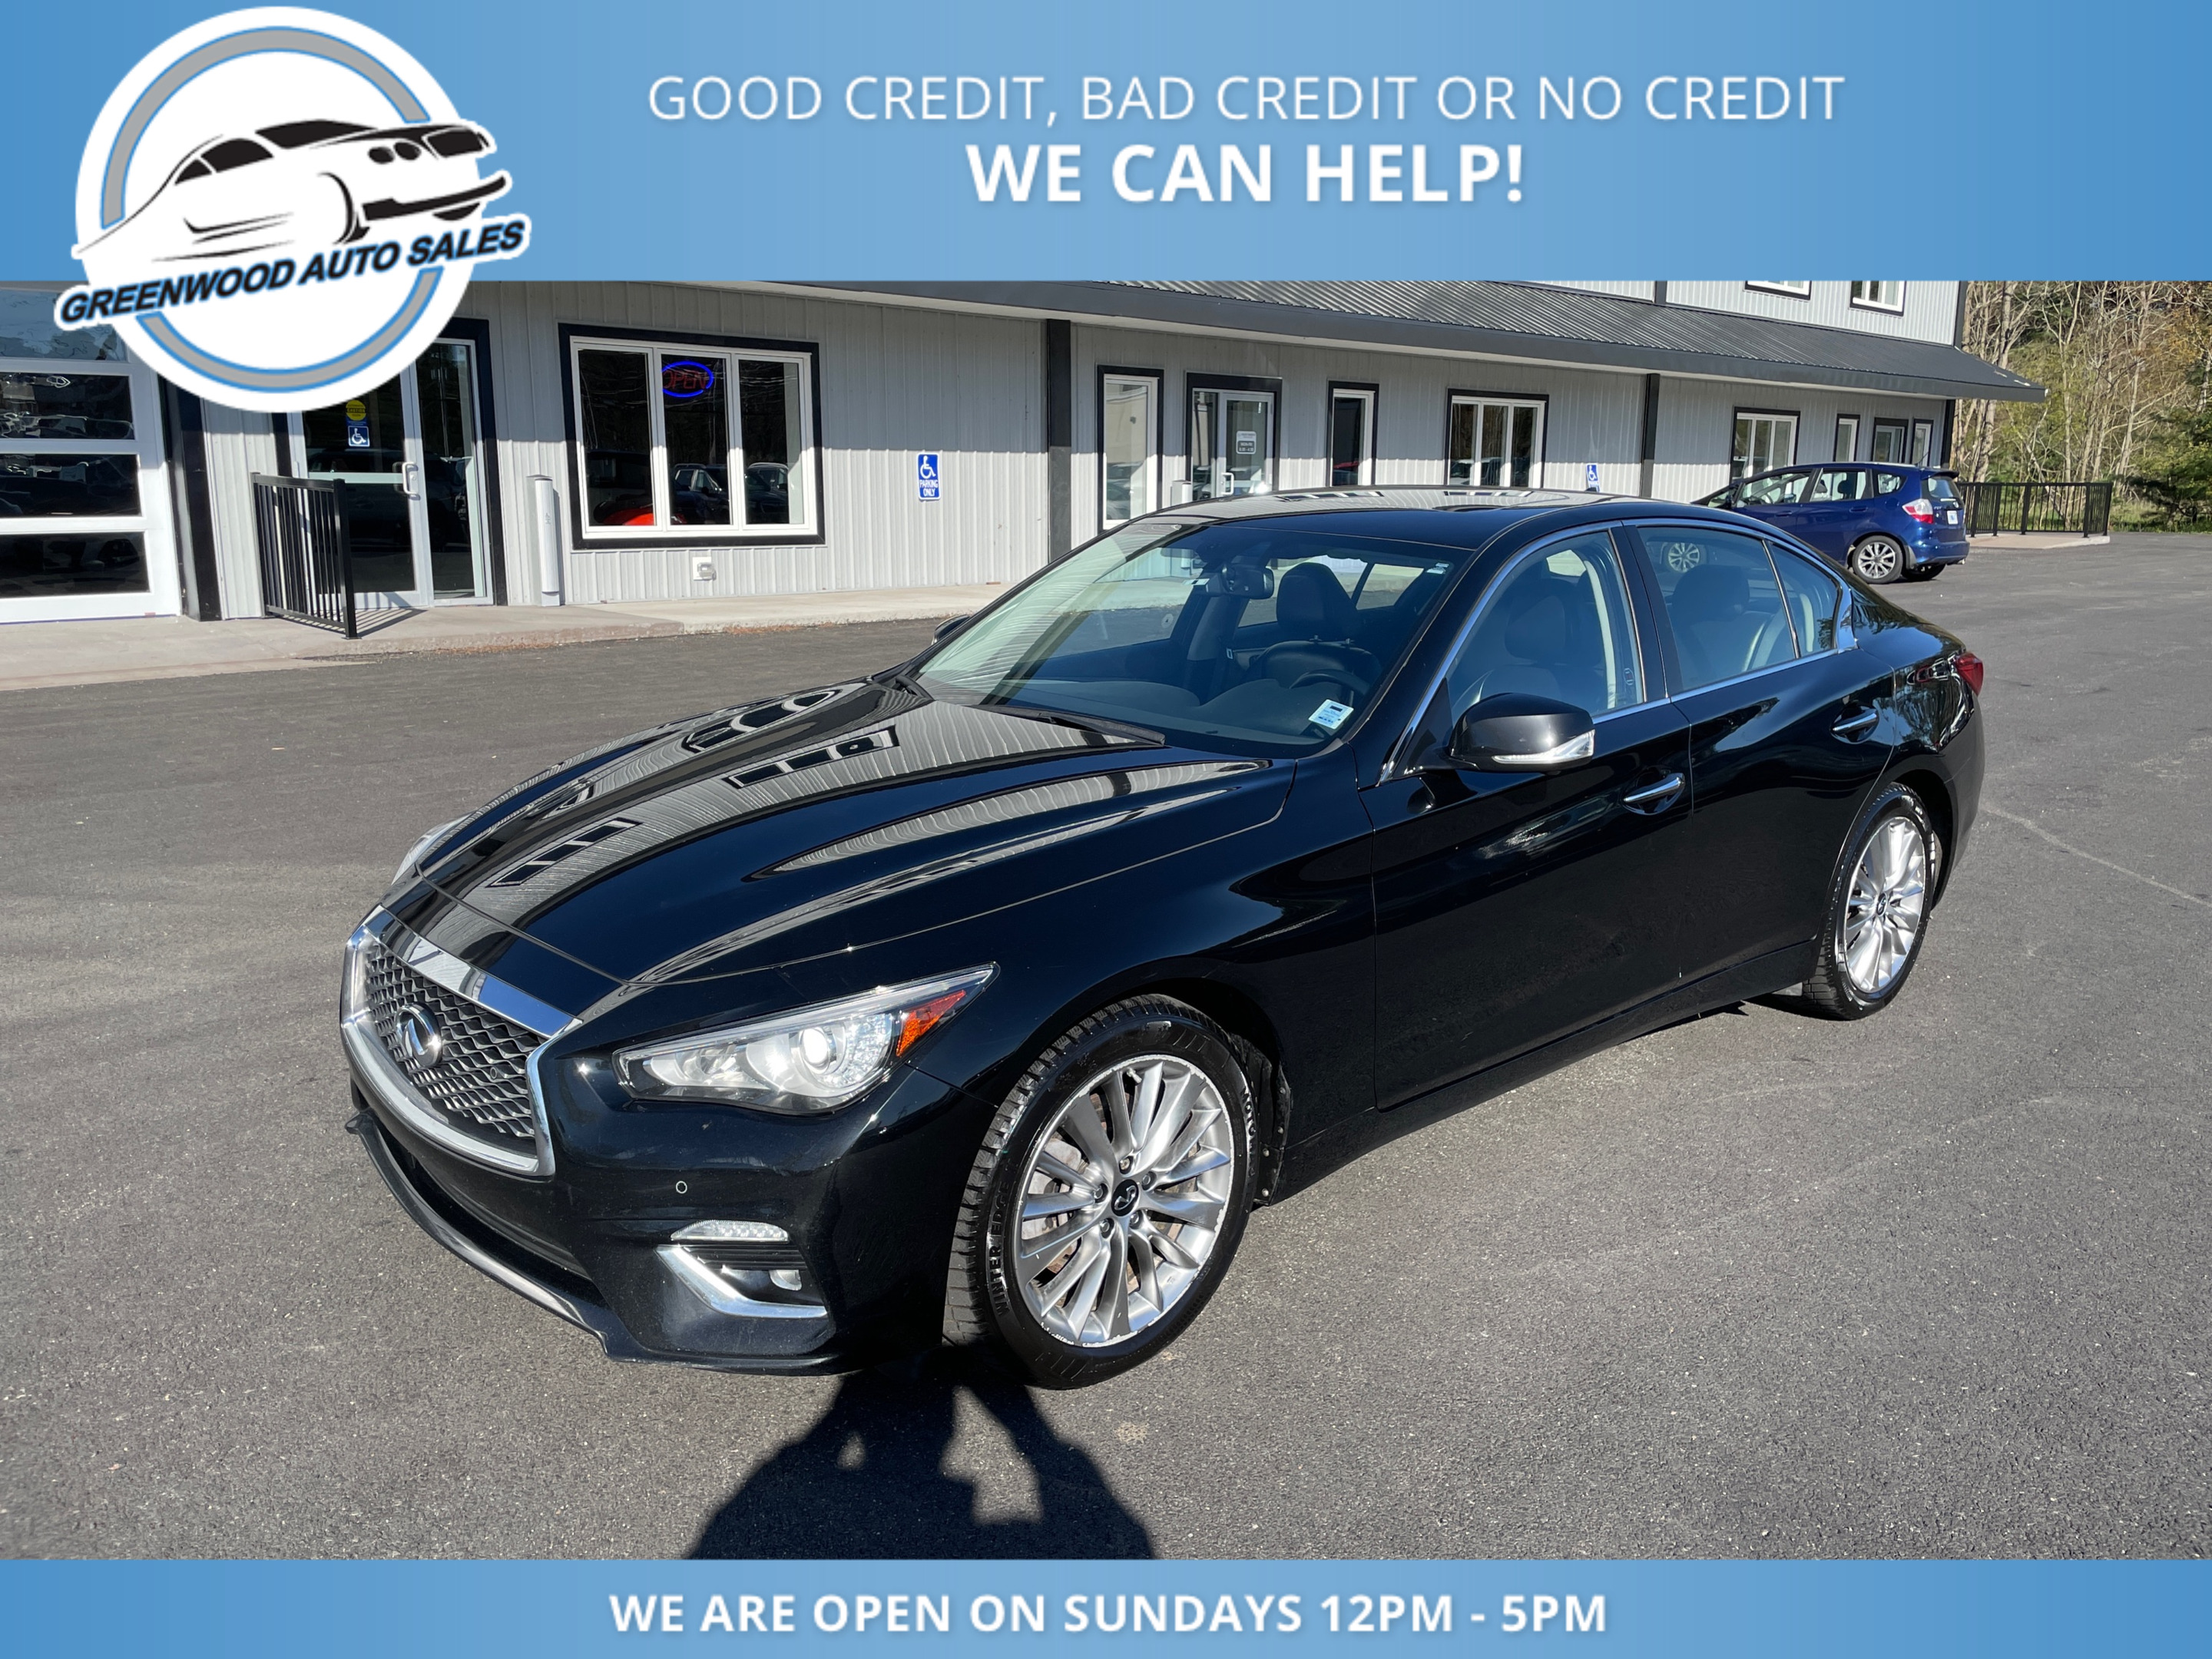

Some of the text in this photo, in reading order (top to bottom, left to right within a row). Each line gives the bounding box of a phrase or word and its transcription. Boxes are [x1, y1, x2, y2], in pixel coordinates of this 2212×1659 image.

[662, 369, 708, 389] OPEN
[919, 479, 939, 488] PARKING
[923, 488, 935, 497] ONLY
[988, 1181, 1012, 1318] WINTER EDGE
